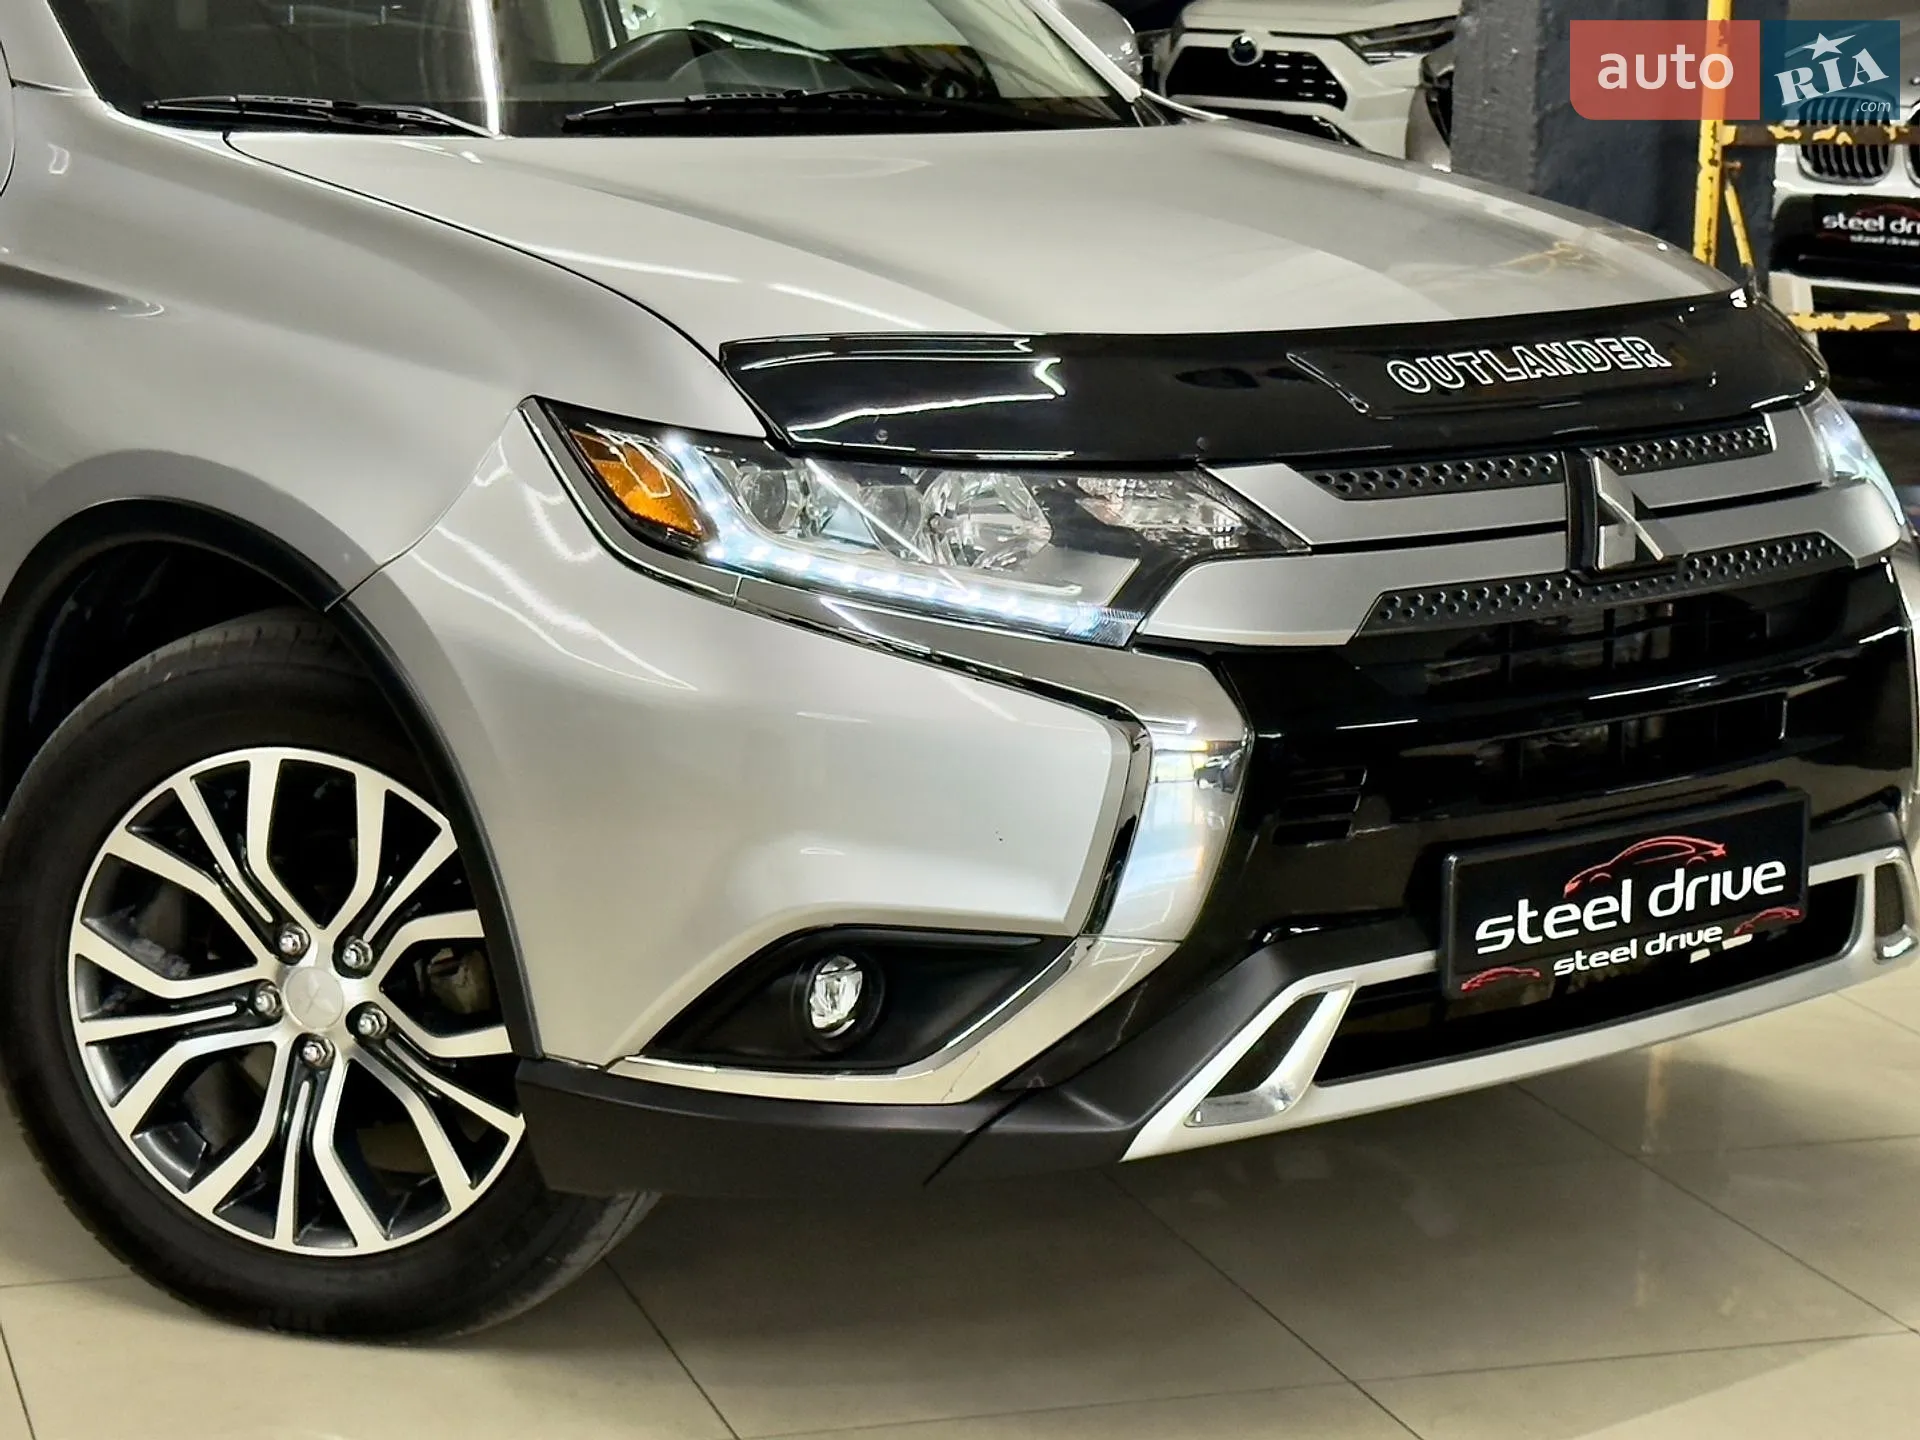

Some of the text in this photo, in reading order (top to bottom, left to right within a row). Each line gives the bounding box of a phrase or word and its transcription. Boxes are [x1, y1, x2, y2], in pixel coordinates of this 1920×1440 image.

[1822, 212, 1884, 232] steel
[1386, 336, 1673, 394] OUTLANDER
[1475, 860, 1787, 955] steel drive
[1553, 925, 1723, 977] steel drive
